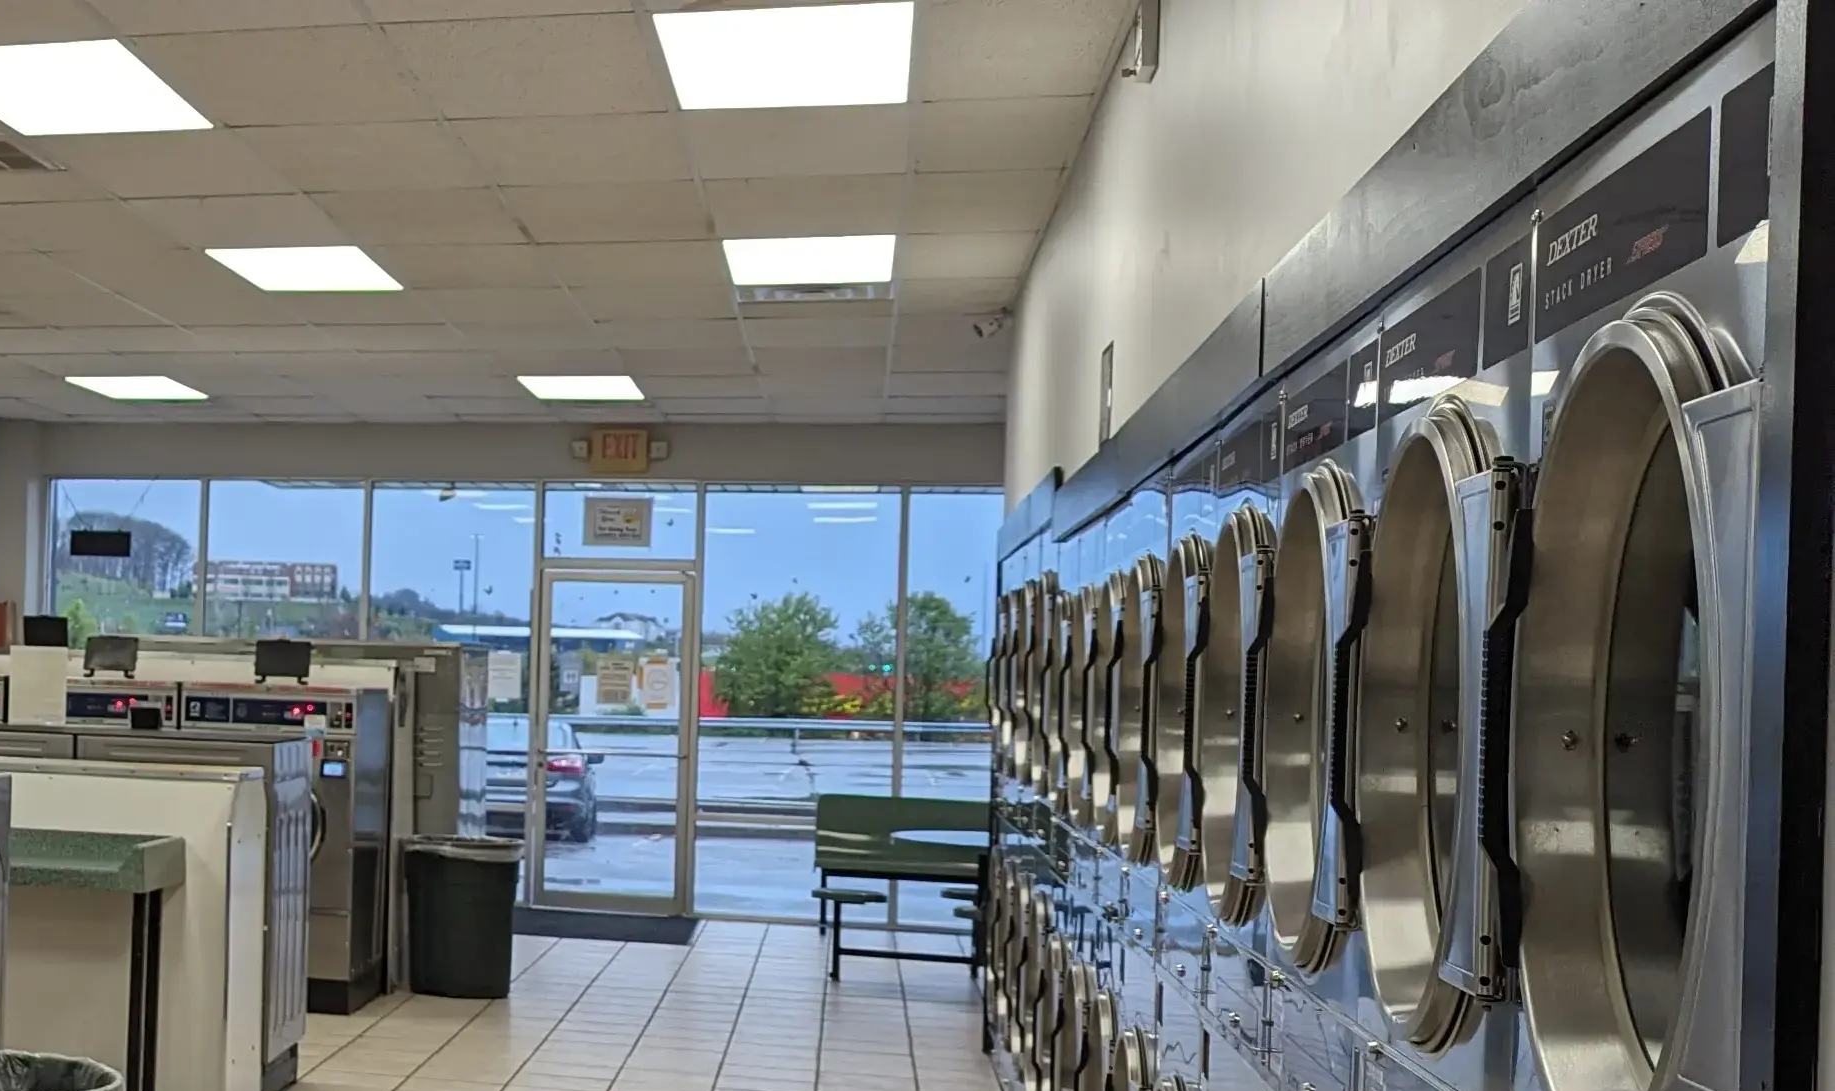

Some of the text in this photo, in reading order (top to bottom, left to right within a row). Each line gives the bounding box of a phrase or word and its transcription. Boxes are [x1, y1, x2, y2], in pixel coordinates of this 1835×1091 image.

[1546, 213, 1599, 267] DEXTER
[1545, 256, 1612, 310] STACK DRYER
[1385, 332, 1417, 368] DEXTER
[602, 434, 641, 460] EXIT
